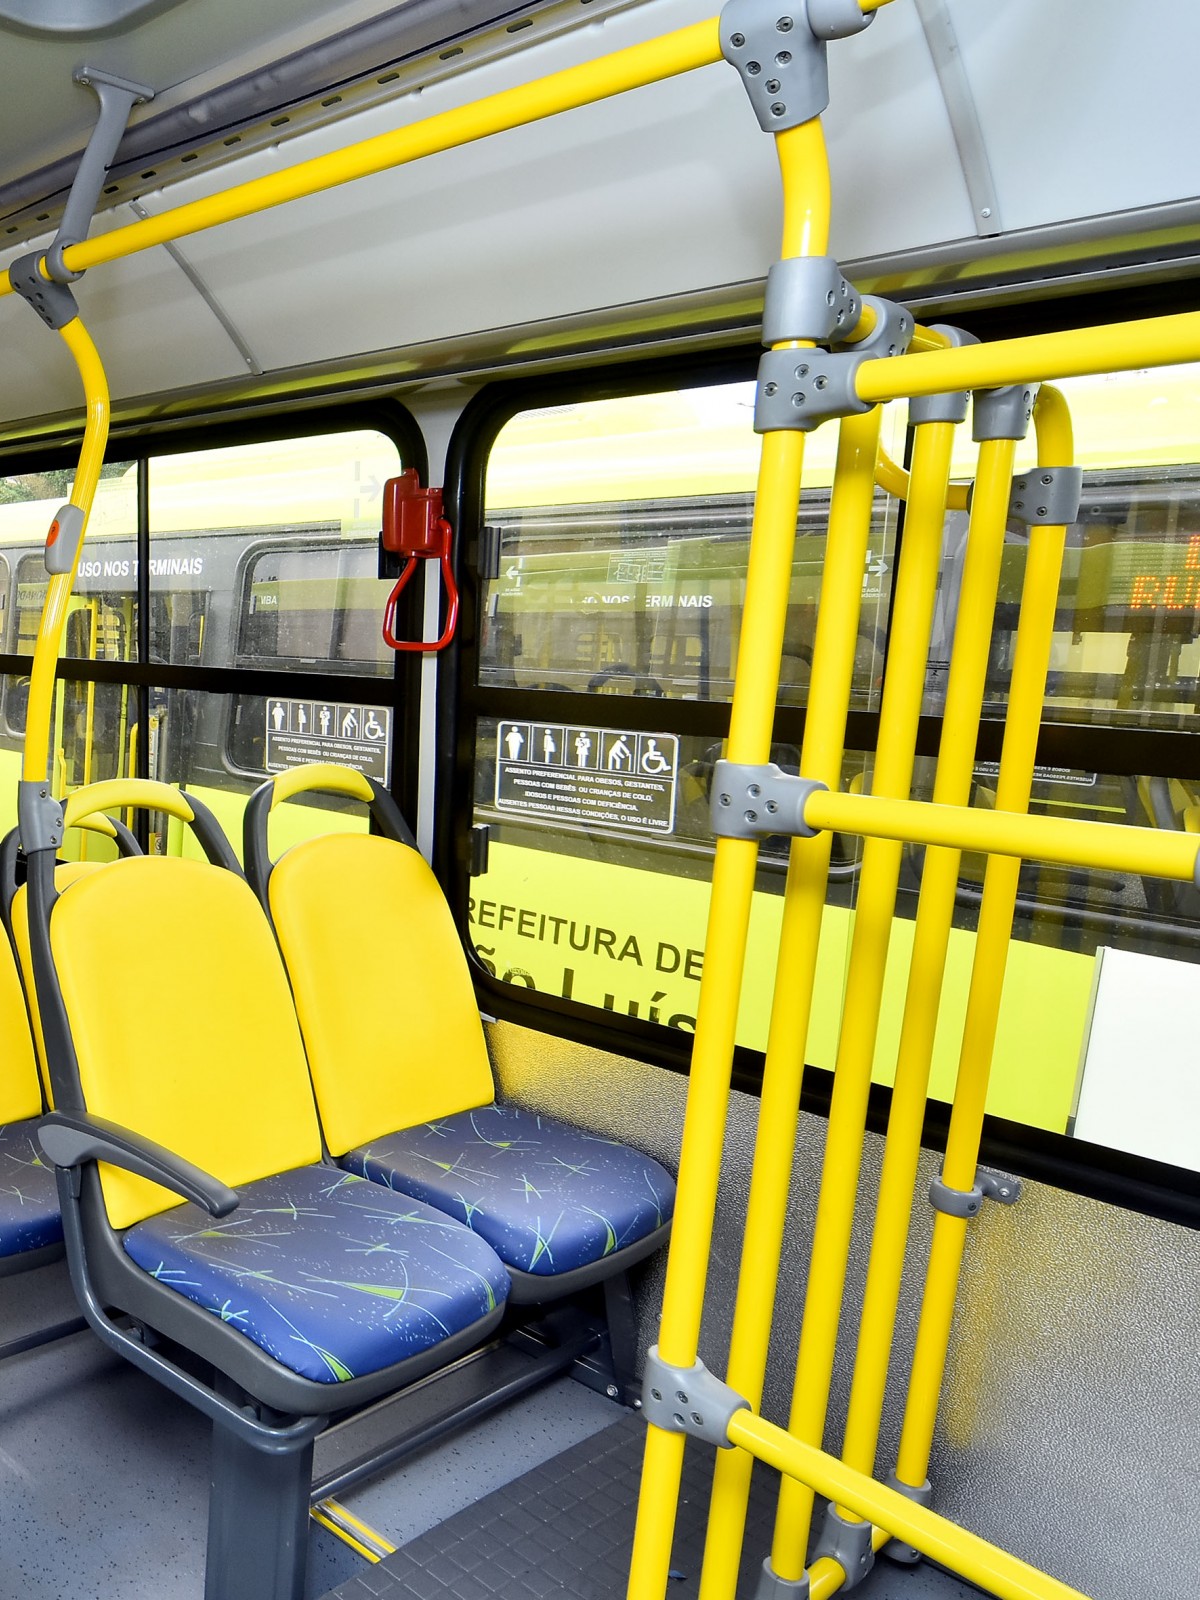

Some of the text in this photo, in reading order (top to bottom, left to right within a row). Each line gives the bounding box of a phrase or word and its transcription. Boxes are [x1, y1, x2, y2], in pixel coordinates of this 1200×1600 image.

[78, 557, 203, 577] USO NOS TRMINAIS
[636, 595, 713, 608] ERMNAIS
[1130, 575, 1200, 610] RU
[505, 767, 532, 775] ASSENTO
[532, 770, 576, 780] PREFERENCIAL
[577, 775, 594, 783] PARA
[624, 781, 665, 792] GESTANTES,
[513, 778, 541, 787] PESSOAS
[556, 784, 576, 792] BEBÊS
[589, 787, 621, 798] CRIANÇAS
[525, 791, 547, 799] IDOSOS
[553, 794, 581, 803] PESSOAS
[582, 798, 597, 806] COM
[498, 798, 528, 807] AUSENTES
[528, 802, 556, 811] PESSOAS
[556, 806, 580, 815] NESSAS
[627, 815, 641, 823] USO
[468, 897, 704, 982] REFEITURA DE
